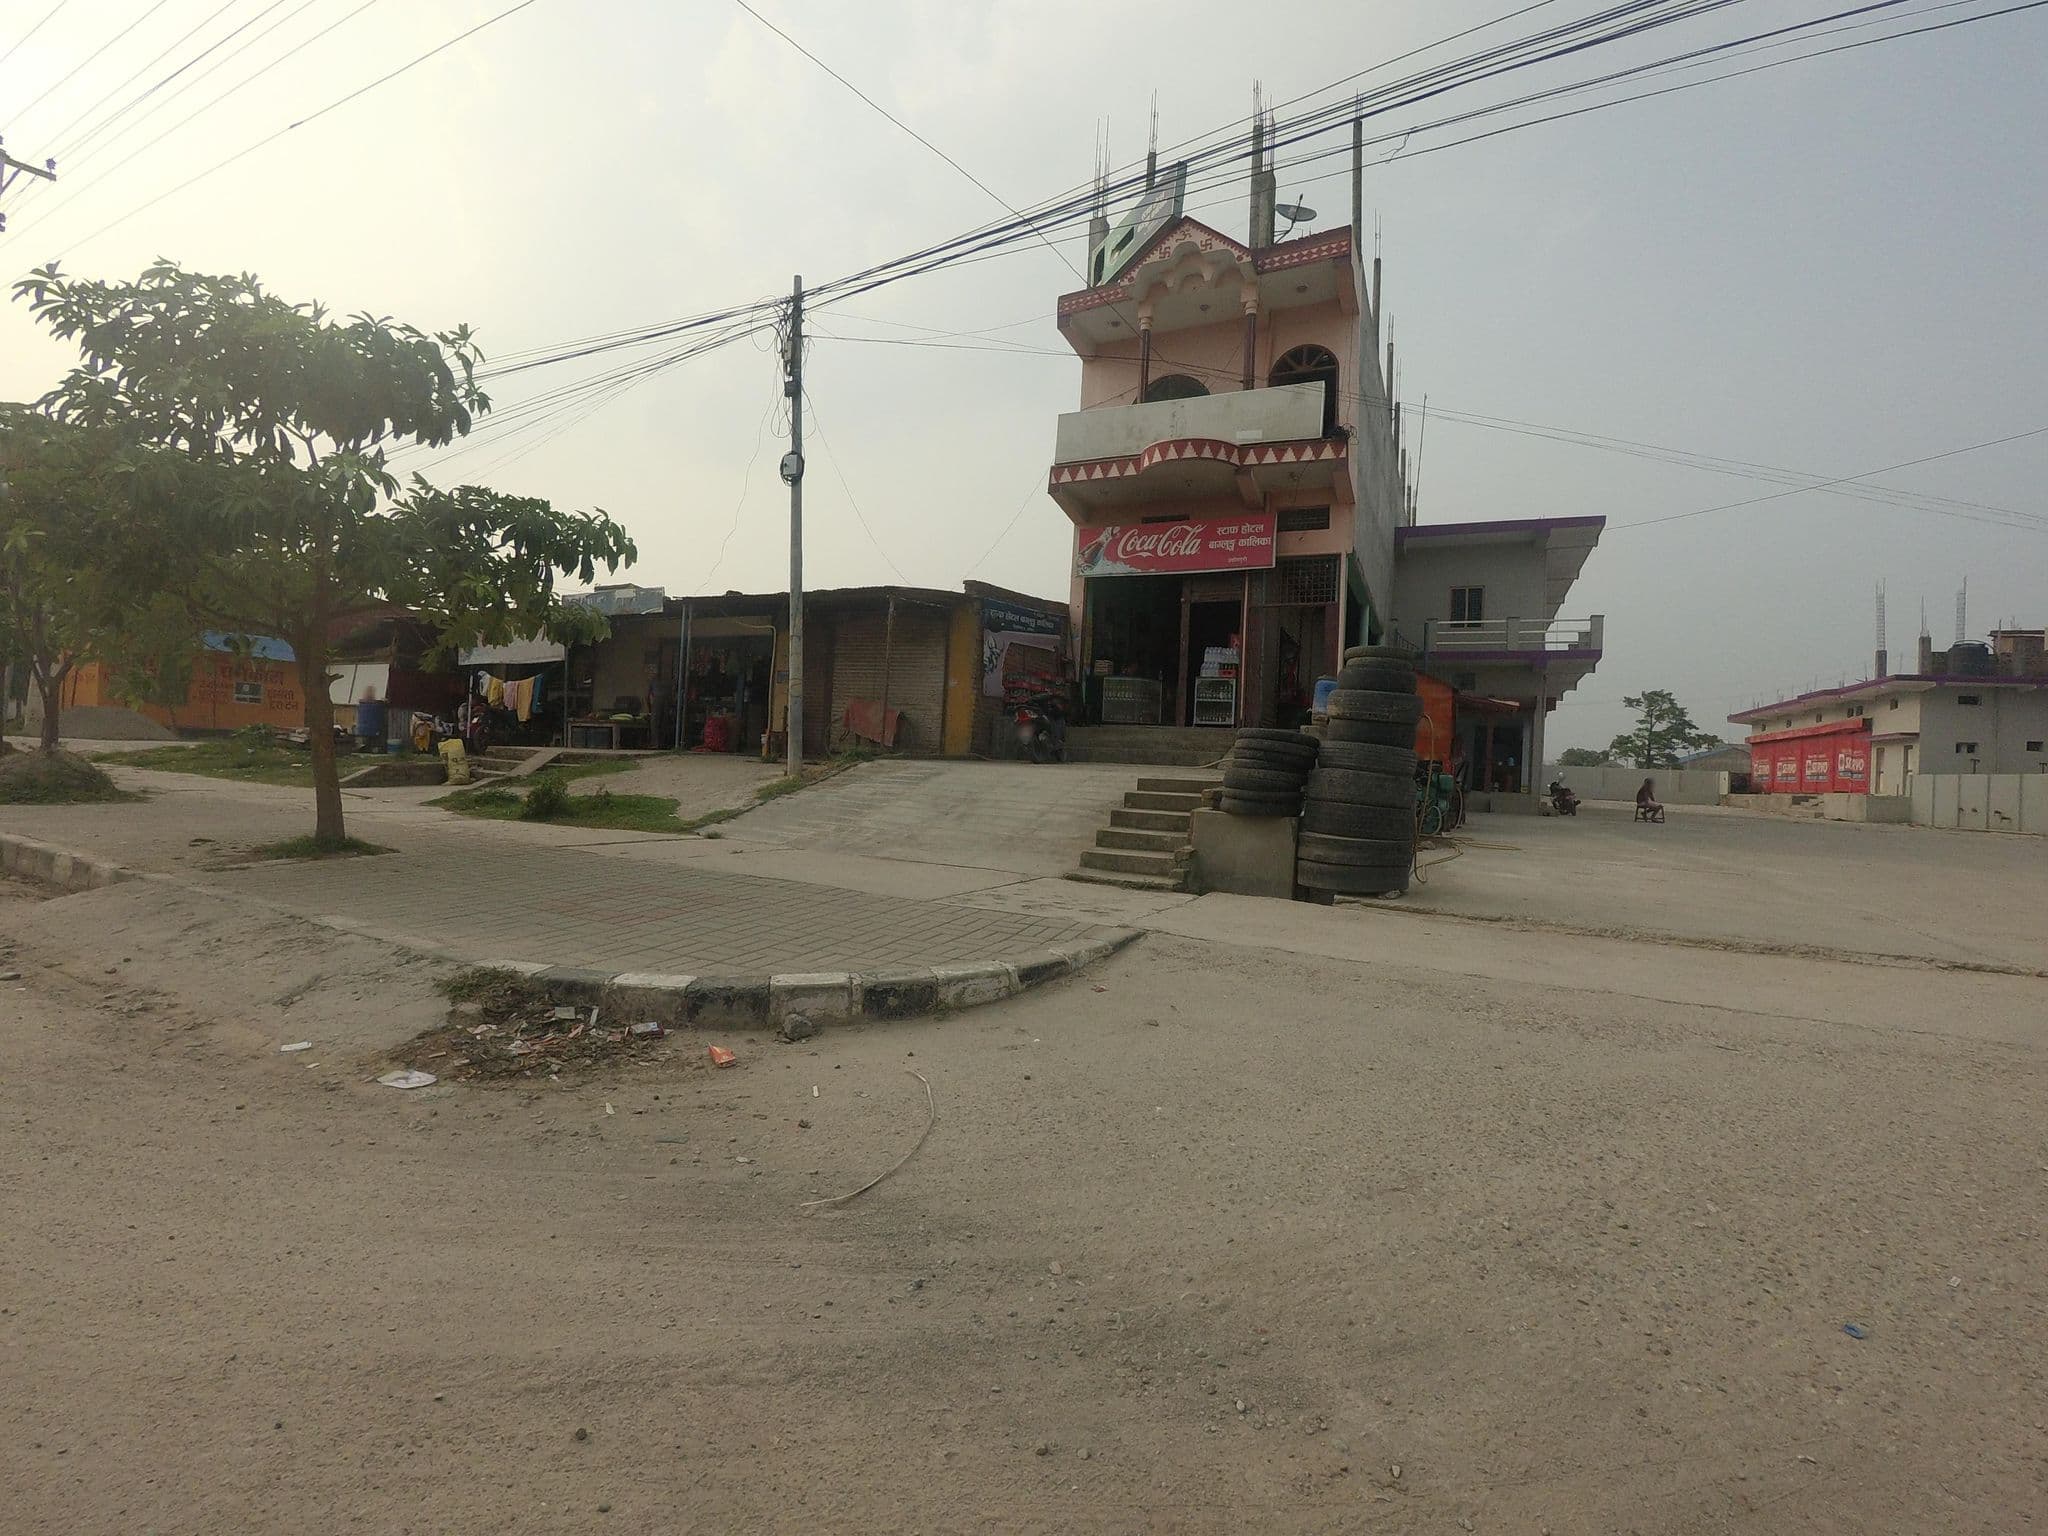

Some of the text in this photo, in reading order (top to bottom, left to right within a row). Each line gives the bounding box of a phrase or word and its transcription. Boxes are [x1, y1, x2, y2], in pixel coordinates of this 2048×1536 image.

[1241, 522, 1264, 535] होटल
[1118, 524, 1207, 559] Coca-Cola
[1238, 535, 1271, 547] कालिका
[1845, 756, 1865, 771] SERVO
